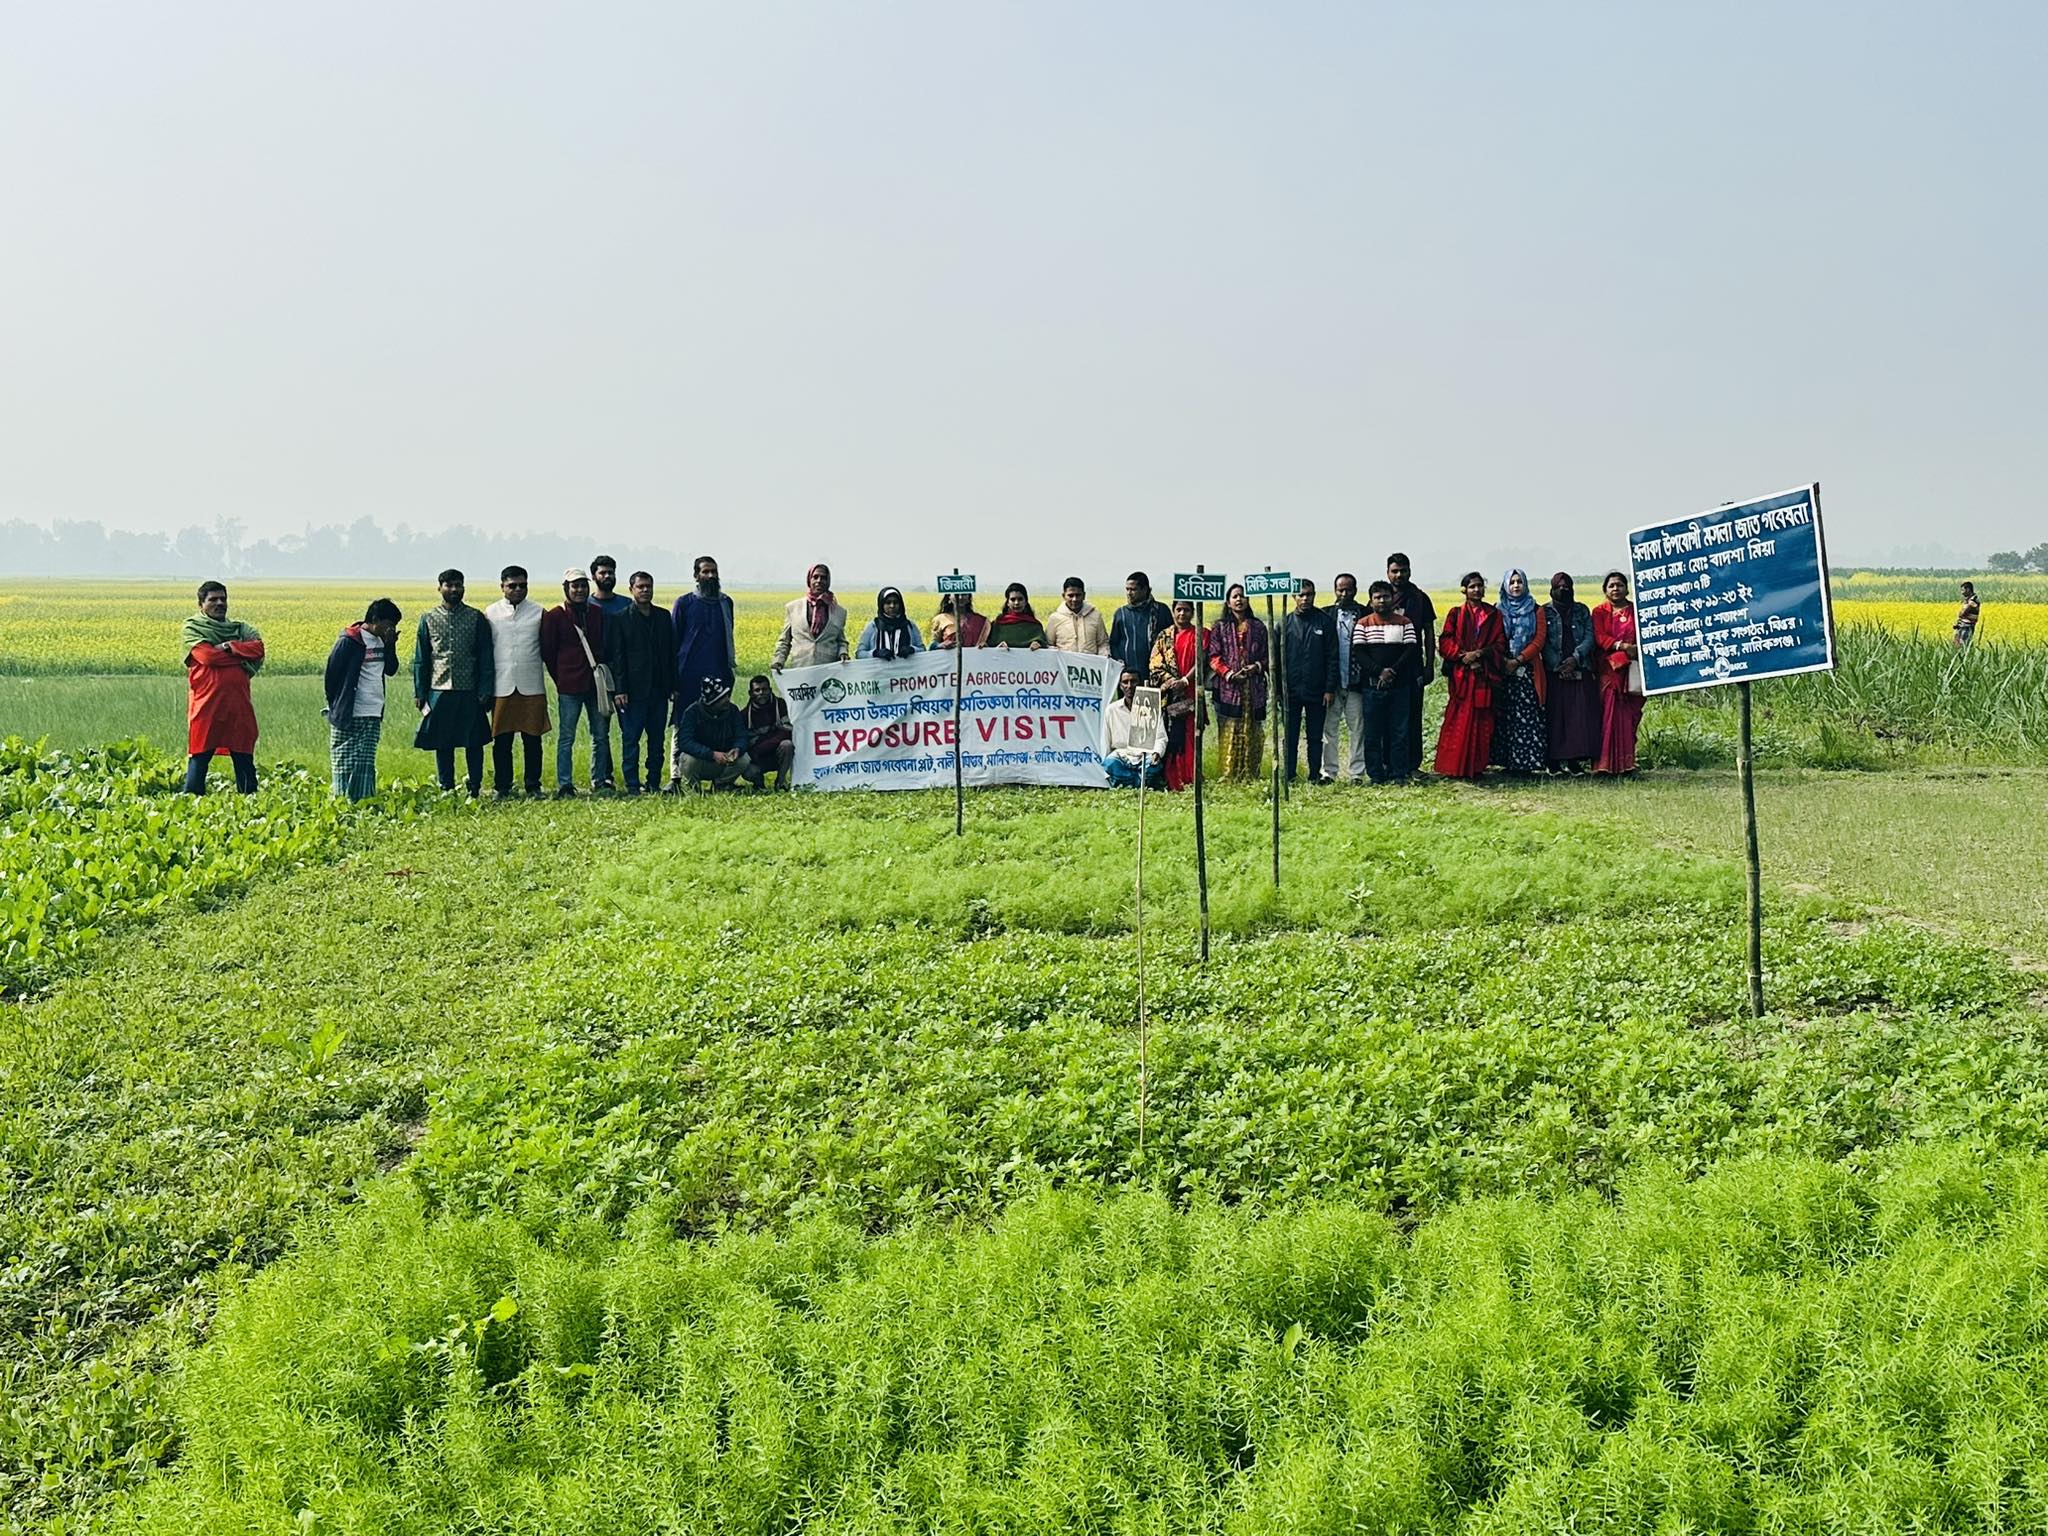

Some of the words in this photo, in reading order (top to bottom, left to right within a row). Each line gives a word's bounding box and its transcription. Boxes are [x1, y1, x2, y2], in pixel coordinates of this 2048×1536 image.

[1703, 521, 1733, 546] মসলা
[1735, 514, 1761, 539] জাত
[1710, 547, 1744, 567] বাদশা
[1178, 576, 1223, 597] ধনিয়া
[890, 673, 958, 693] PROMOTE
[966, 670, 1059, 686] AGROECOLOGY
[1067, 665, 1102, 688] PAN
[822, 706, 865, 724] দক্ষতা
[866, 699, 908, 719] উন্নয়ন
[909, 694, 954, 715] বিষয়ক
[959, 689, 1014, 712] অভিজ্ঞতা
[1016, 688, 1062, 711] বিনিময়
[1064, 695, 1102, 713] সফর
[814, 720, 958, 756] EXPOSURE
[976, 715, 1075, 742] VISIT
